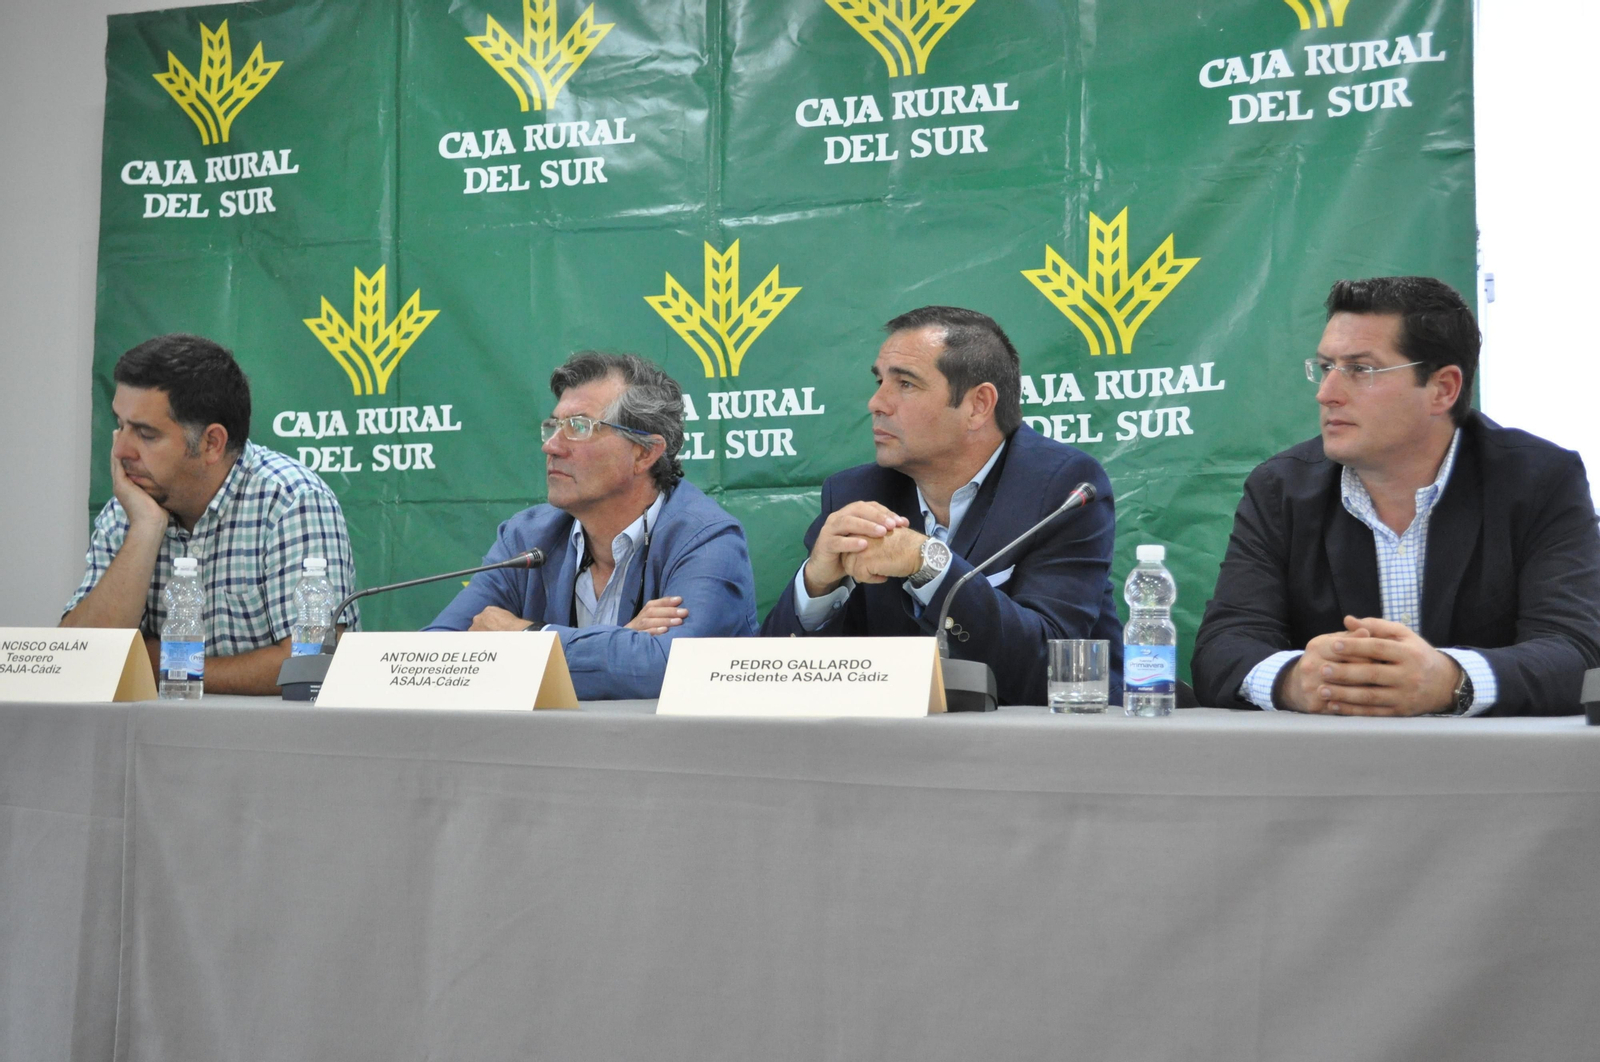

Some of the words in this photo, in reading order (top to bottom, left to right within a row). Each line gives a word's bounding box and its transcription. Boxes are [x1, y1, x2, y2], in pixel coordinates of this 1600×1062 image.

[1199, 48, 1295, 89] CAJA
[1303, 31, 1446, 76] RURAL
[795, 94, 884, 128] CAJA
[891, 82, 1019, 120] RURAL
[1228, 89, 1314, 125] DEL
[1327, 77, 1413, 118] SUR
[438, 128, 517, 160] CAJA
[523, 117, 636, 152] RURAL
[823, 133, 899, 165] DEL
[910, 124, 989, 158] SUR
[121, 159, 198, 187] CAJA
[205, 149, 299, 183] RURAL
[463, 164, 530, 194] DEL
[539, 156, 608, 189] SUR
[143, 193, 209, 218] DEL
[219, 187, 276, 217] SUR
[1019, 372, 1086, 407] AJA
[1094, 361, 1226, 401] RURAL
[707, 386, 825, 420] RURAL
[272, 410, 349, 440] CAJA
[355, 404, 462, 435] RURAL
[1115, 406, 1194, 442] SUR
[297, 446, 362, 473] DEL
[372, 443, 436, 472] SUR
[725, 428, 797, 459] SUR
[7, 652, 54, 663] Tesorero
[48, 639, 89, 652] GALÁN
[380, 652, 440, 663] ANTONIO
[441, 652, 460, 663] DE
[461, 651, 498, 663] LEÓN
[389, 676, 471, 687] ASAJA-Cádiz
[390, 664, 480, 676] Vicepresidente
[710, 671, 789, 682] Presidente
[791, 671, 843, 682] ASAJA
[847, 670, 889, 682] Cádiz
[730, 659, 784, 670] PEDRO
[787, 659, 872, 670] GALLARDO
